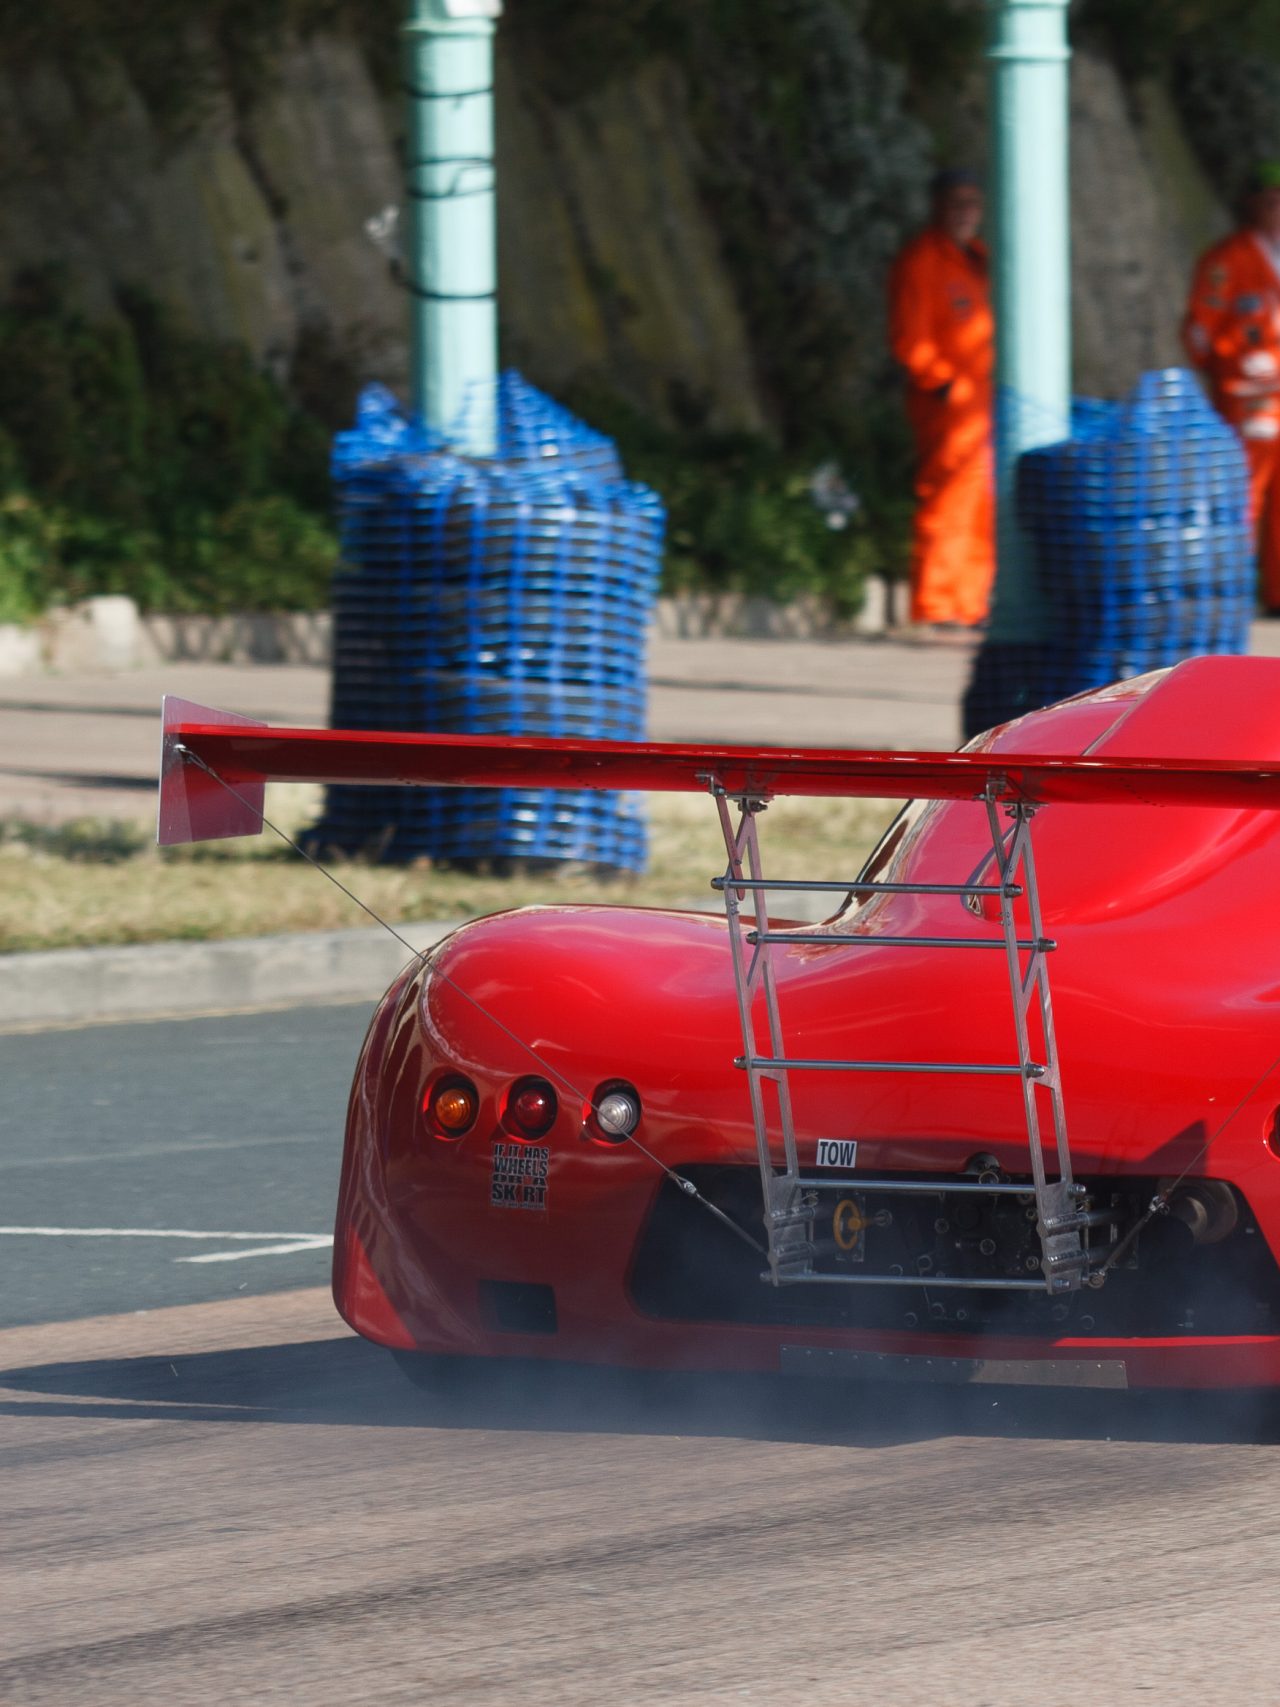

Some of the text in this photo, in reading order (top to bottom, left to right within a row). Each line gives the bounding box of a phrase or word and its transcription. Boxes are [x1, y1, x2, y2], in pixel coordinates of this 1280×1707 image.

[494, 1144, 549, 1160] IF IT HAS
[820, 1141, 855, 1166] TOW
[494, 1156, 548, 1177] WHEELS
[493, 1173, 546, 1186] OR A
